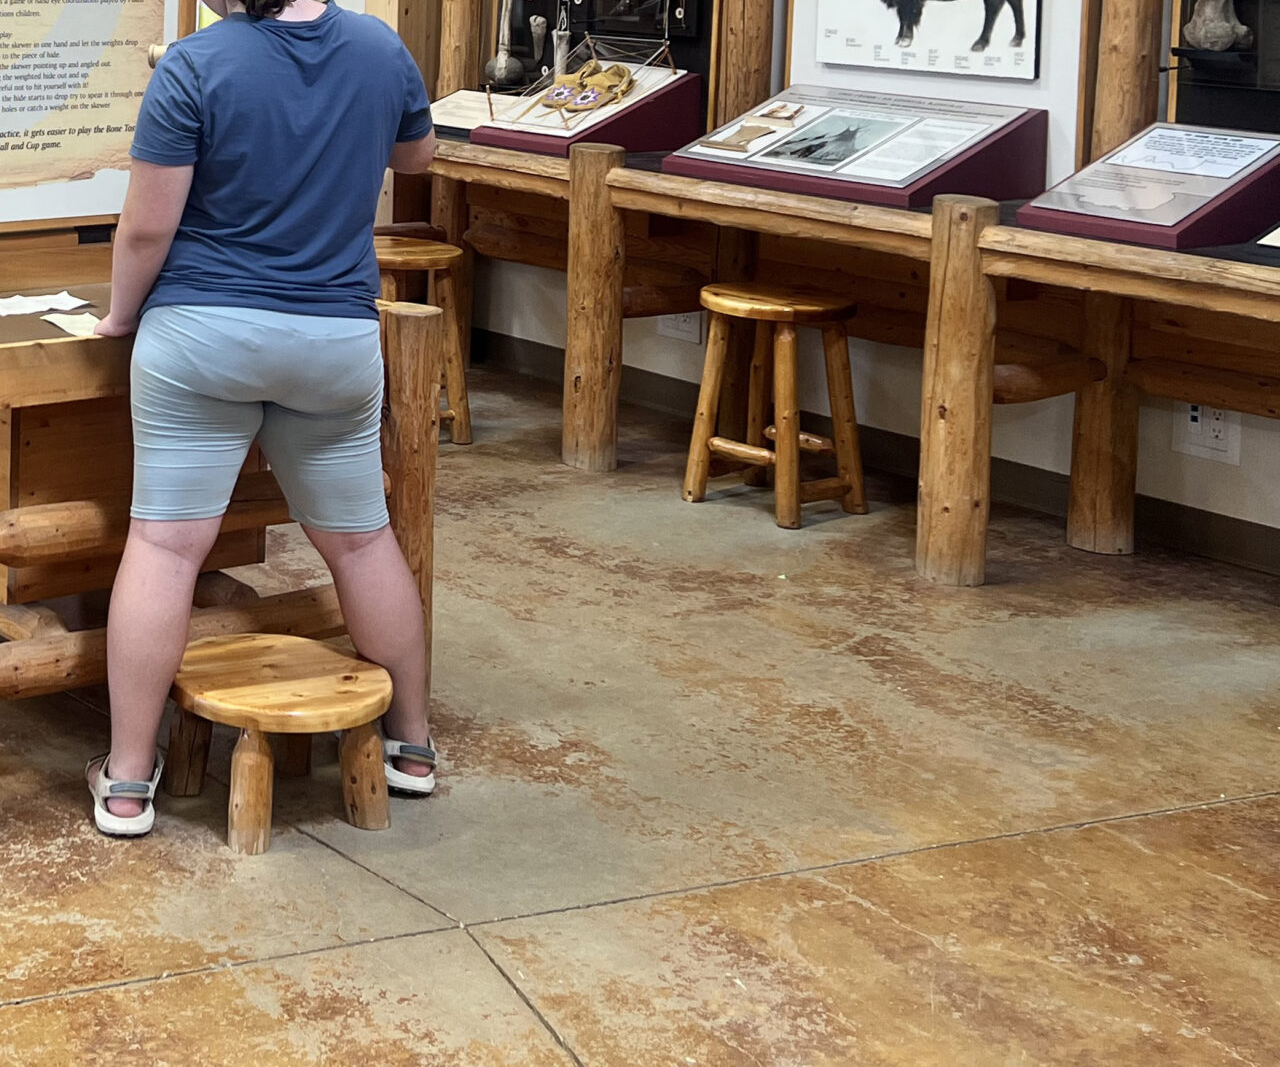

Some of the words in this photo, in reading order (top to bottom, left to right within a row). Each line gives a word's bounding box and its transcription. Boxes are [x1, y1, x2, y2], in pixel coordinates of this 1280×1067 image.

[23, 128, 29, 137] it
[30, 128, 45, 139] gets
[46, 127, 67, 136] easier
[68, 126, 76, 135] to
[77, 126, 92, 137] play
[93, 125, 105, 134] the
[106, 125, 122, 133] Bone
[10, 141, 24, 150] and
[26, 141, 40, 151] Cup
